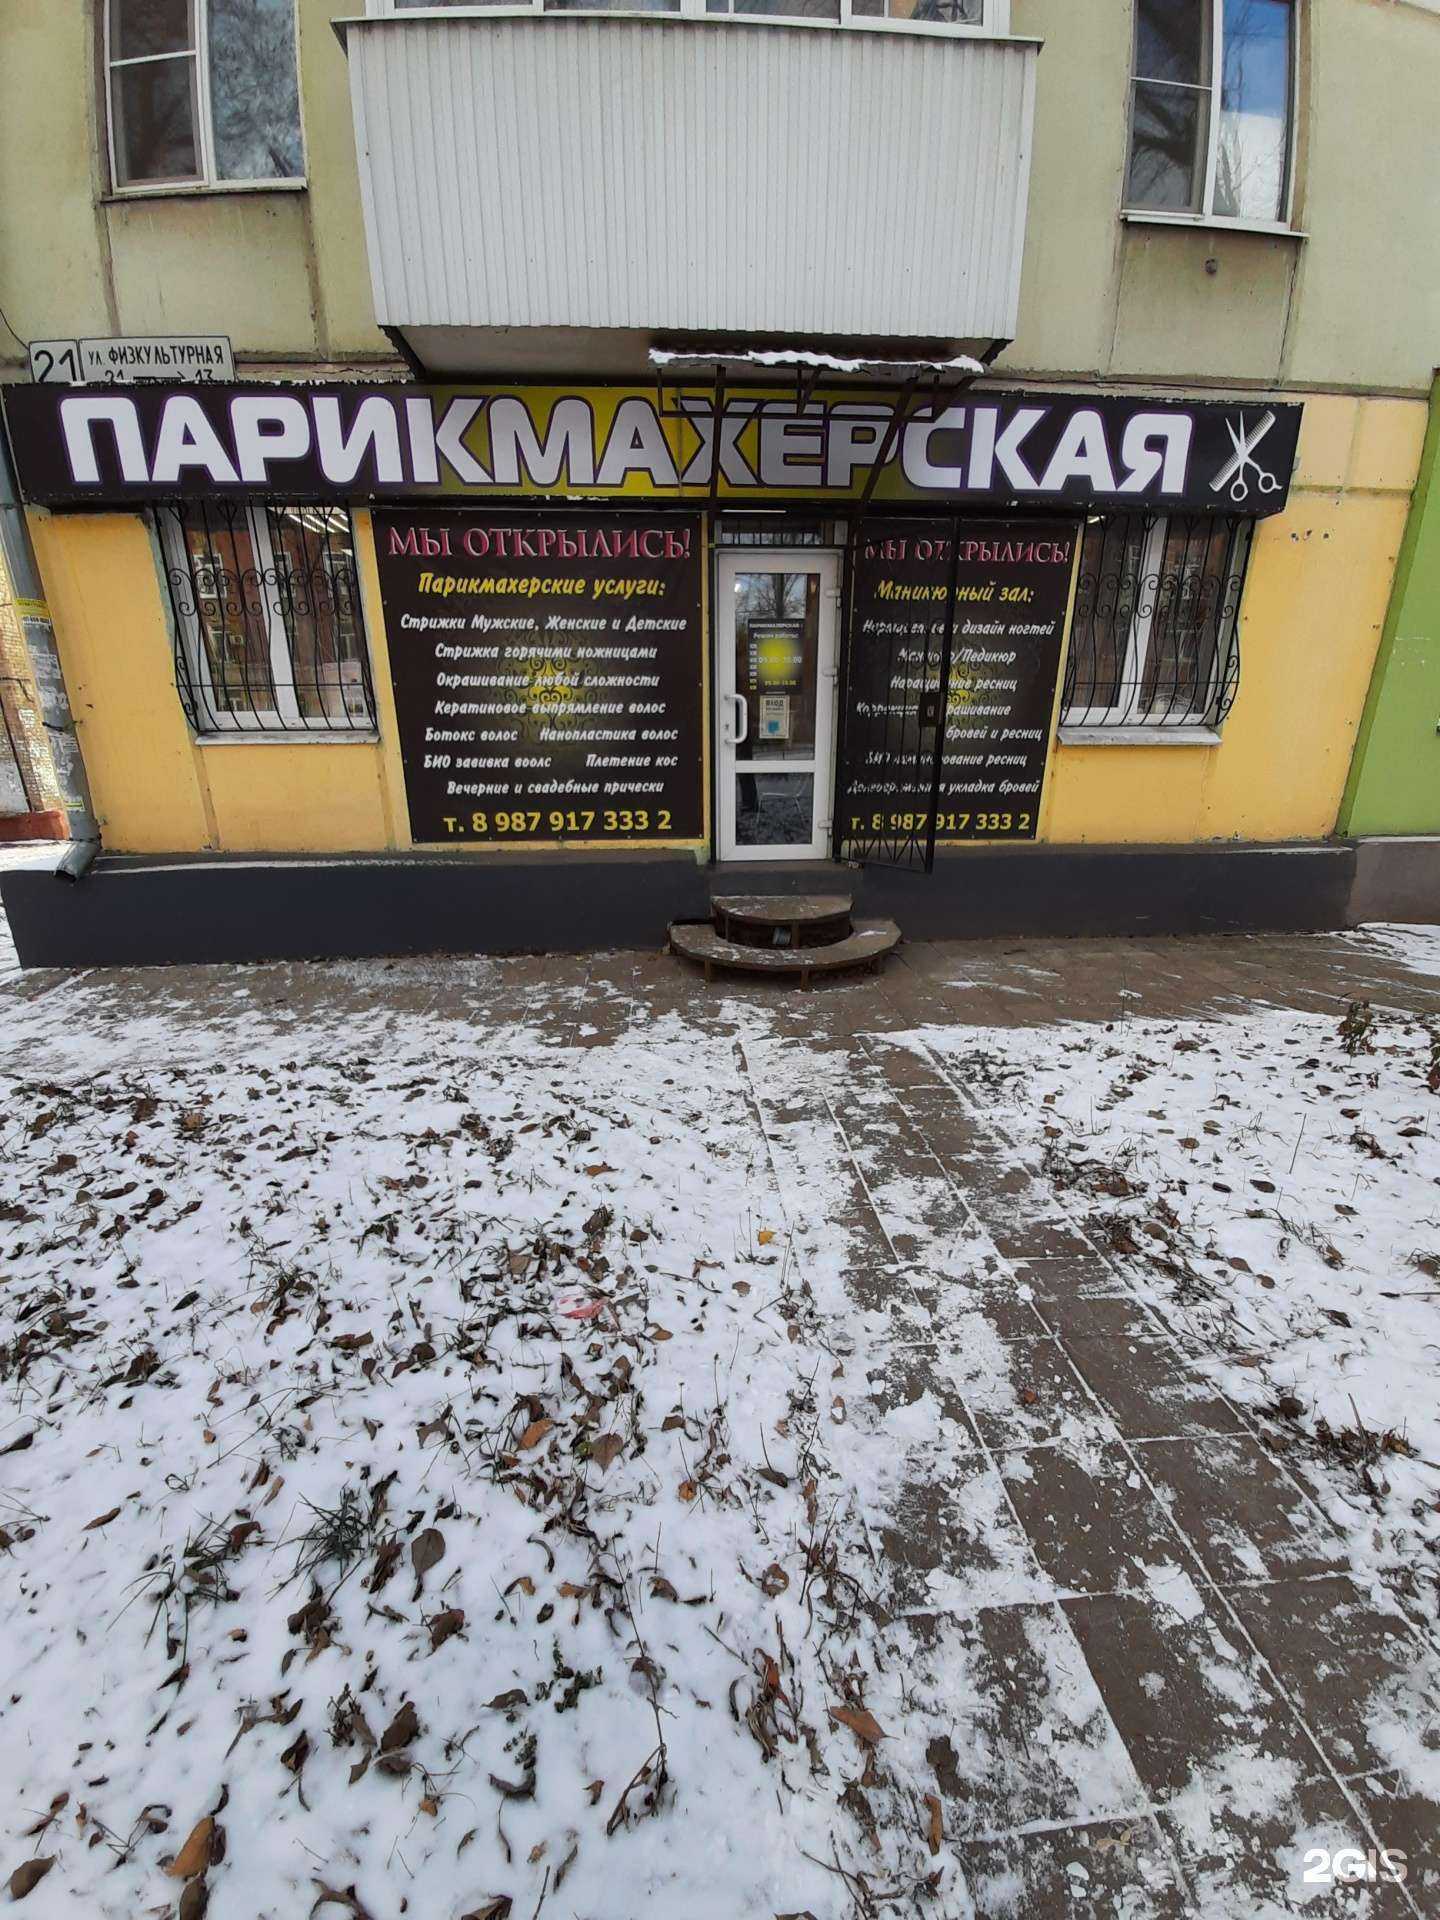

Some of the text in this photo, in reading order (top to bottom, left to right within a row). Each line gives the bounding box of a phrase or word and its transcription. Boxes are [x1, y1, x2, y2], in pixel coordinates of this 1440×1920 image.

[108, 345, 224, 365] ФИЗКУЛЬТУРНАЯ
[34, 348, 77, 383] 21
[58, 395, 1193, 494] ПАРИКМАХЕРСКАЯ
[387, 526, 692, 560] МЫ ОТКРЫЛИСЬ!
[418, 571, 667, 600] Парикмахерские услуги:
[875, 578, 1035, 602] Маникюный зал:
[400, 613, 688, 633] Стрижки Мужские, Женские и Детские
[961, 618, 1004, 636] дизайн
[1008, 620, 1056, 636] ногтей
[435, 642, 658, 662] Стрижка горячими ножницами
[436, 671, 661, 688] Окрашивание любой сложности
[974, 678, 1018, 692] ресниц
[435, 700, 667, 716] Кератиновое выпрямление волос
[946, 705, 1012, 717] рашивание
[425, 727, 519, 742] Ботокс волос
[540, 727, 679, 742] Нанопластика волос
[946, 725, 1043, 742] бровей и ресниц
[423, 754, 552, 769] БИО завивка воолс
[586, 753, 679, 768] Плетение кос
[985, 754, 1028, 768] ресниц
[447, 778, 664, 796] Вечерние и свадебные прически
[948, 778, 994, 796] укладка
[999, 779, 1041, 795] бровей
[443, 809, 672, 833] т. 8 987 917 333 2
[935, 813, 971, 831] 917
[975, 813, 1013, 831] 333
[1018, 813, 1030, 830] 2
